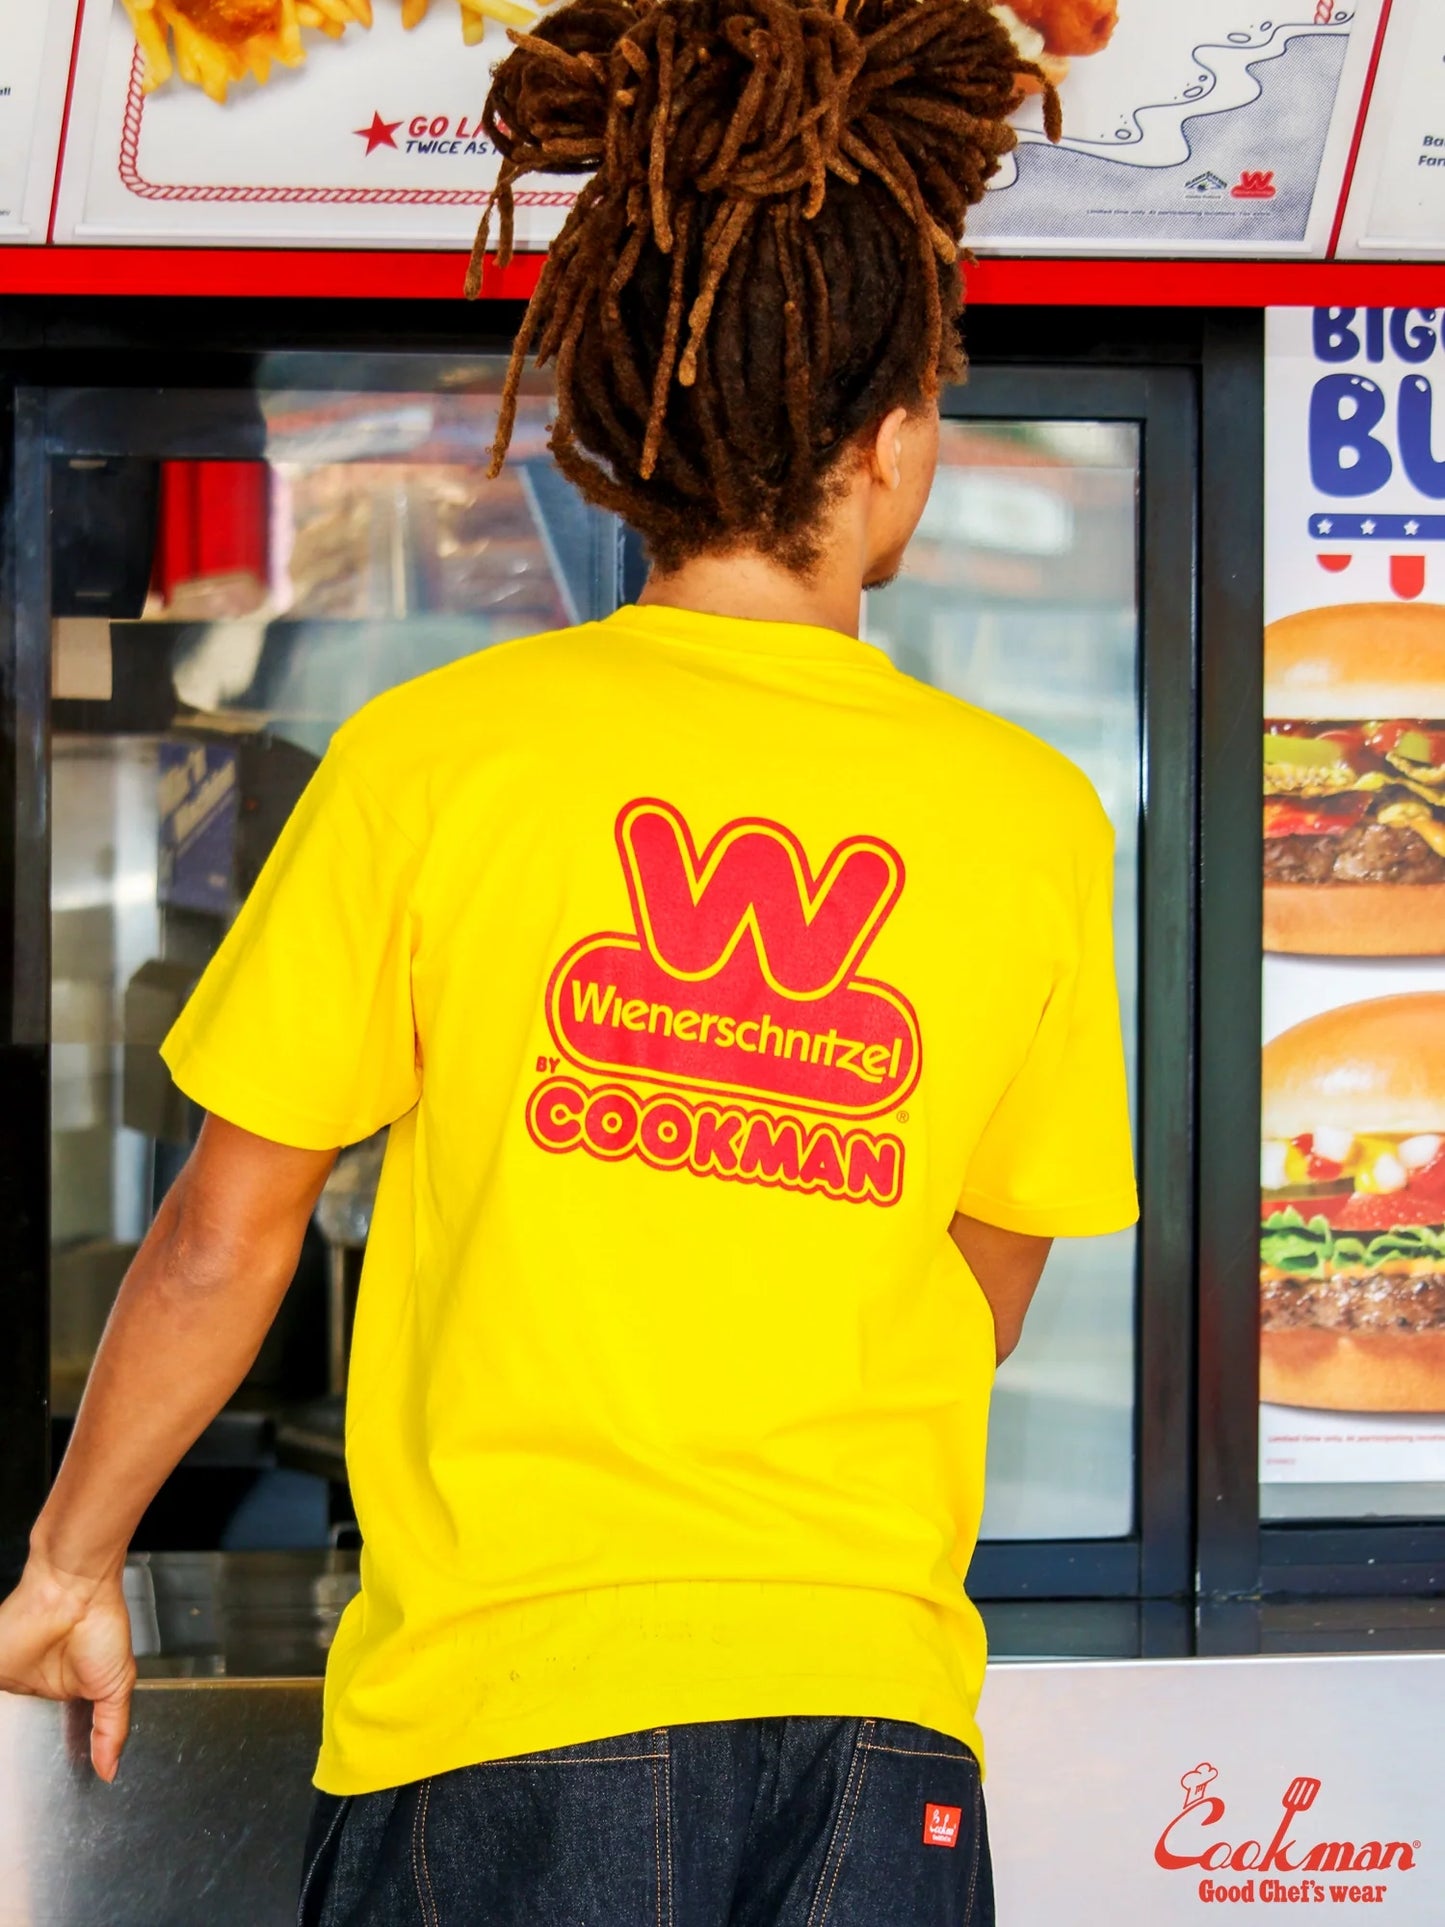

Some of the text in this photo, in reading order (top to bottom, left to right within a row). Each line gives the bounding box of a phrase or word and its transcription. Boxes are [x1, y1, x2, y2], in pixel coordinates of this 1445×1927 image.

[405, 140, 461, 154] TWICE
[464, 140, 488, 154] AS
[408, 116, 449, 138] GO
[1312, 307, 1445, 363] BIG
[616, 798, 905, 1001] W
[571, 980, 903, 1084] Wienerschnitzel
[536, 1056, 560, 1074] BY
[525, 1076, 905, 1207] COOKMAN
